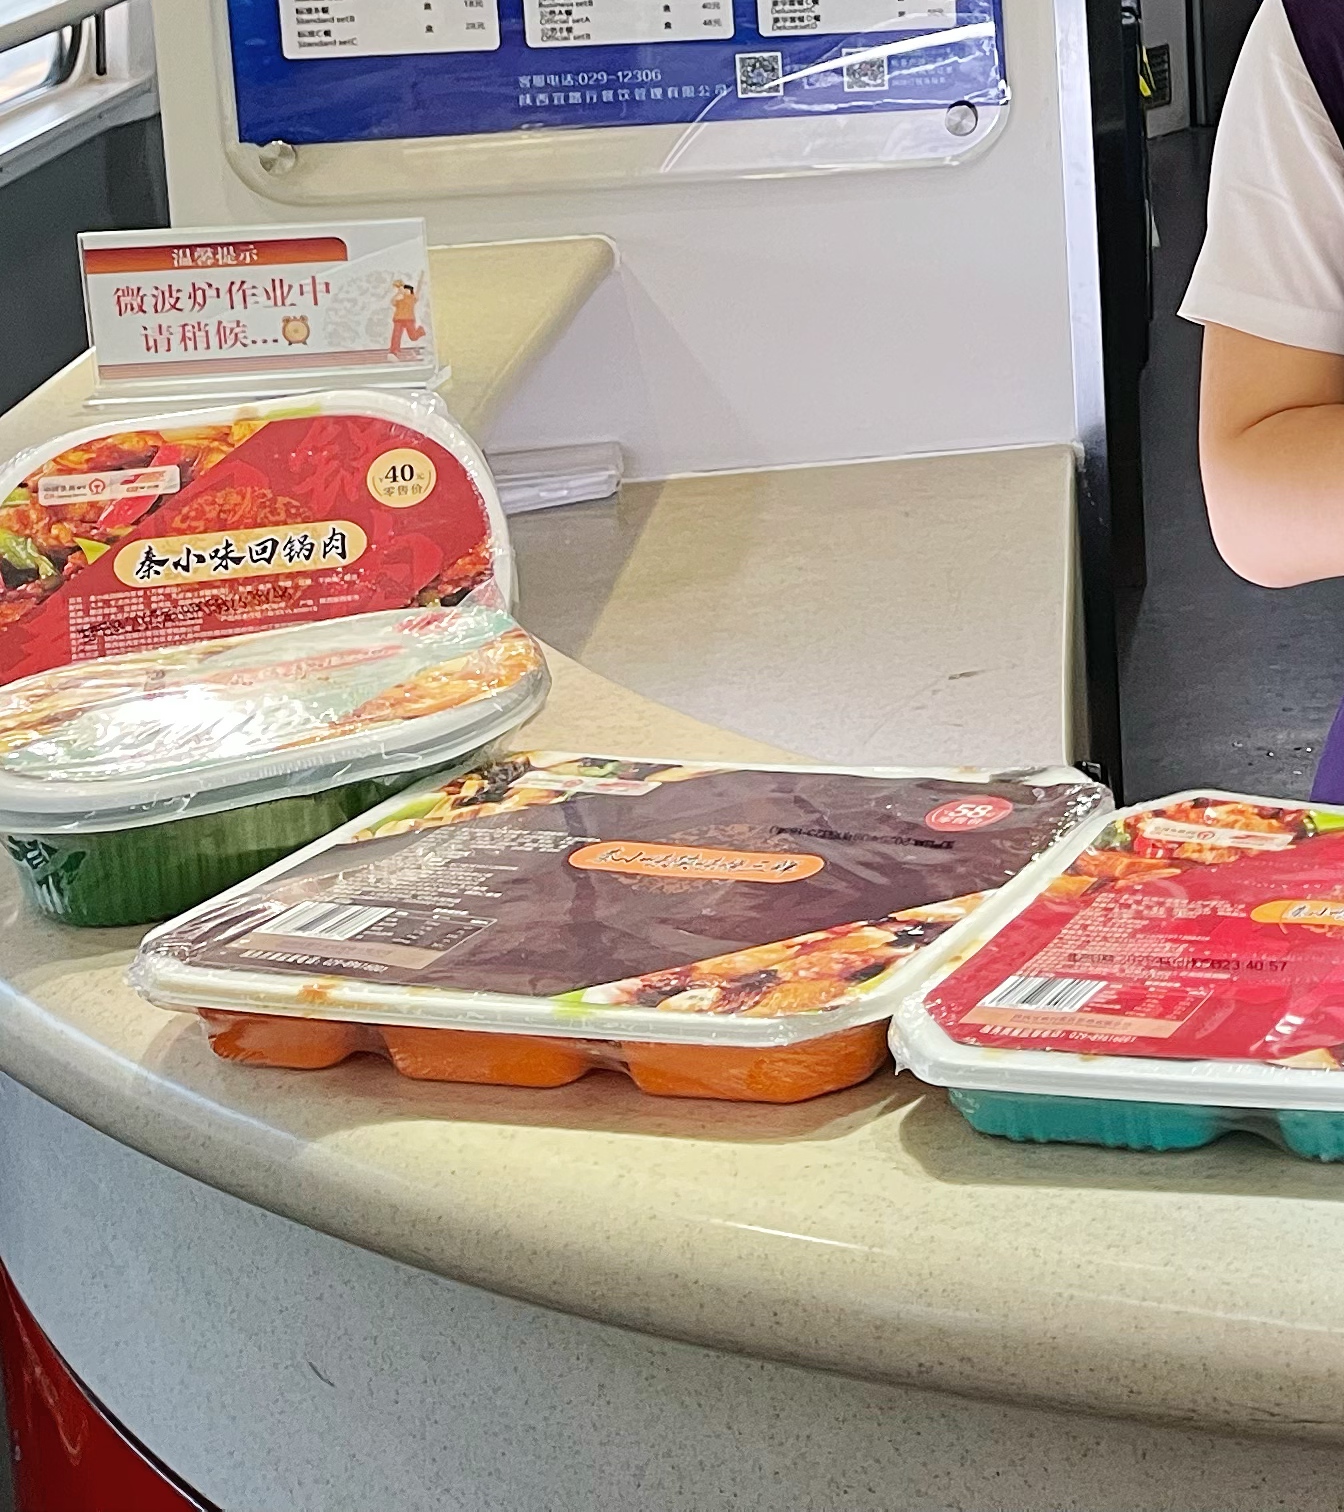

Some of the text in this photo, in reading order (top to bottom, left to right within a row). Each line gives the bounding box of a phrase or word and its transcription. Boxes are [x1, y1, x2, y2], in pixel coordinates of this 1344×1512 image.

[171, 245, 257, 268] 温馨提示
[115, 276, 331, 316] 微波炉作业中
[383, 483, 423, 497] 零售价
